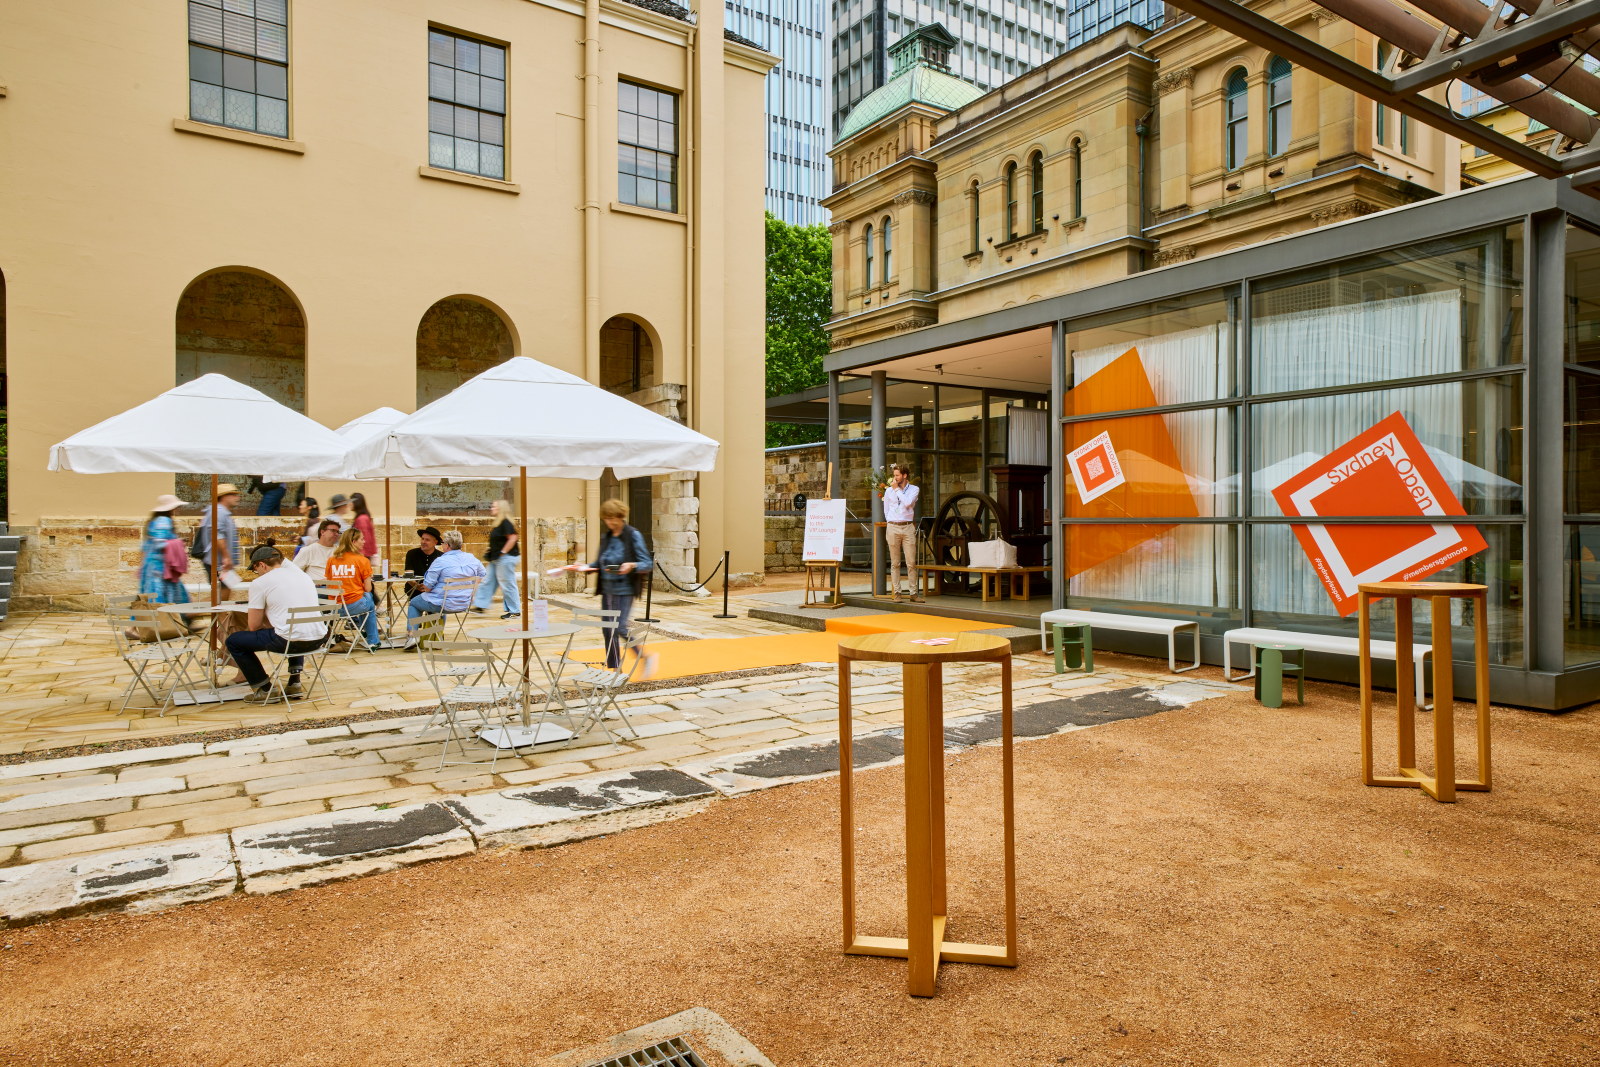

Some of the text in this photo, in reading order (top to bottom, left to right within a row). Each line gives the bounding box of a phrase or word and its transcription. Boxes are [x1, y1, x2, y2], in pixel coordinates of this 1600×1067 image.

[1073, 433, 1108, 458] SYDNEY OPEN
[1108, 451, 1121, 476] LOUNGE
[1326, 437, 1396, 486] Sydney
[1395, 458, 1433, 512] Open
[331, 564, 356, 576] MH
[1314, 557, 1343, 603] #sydneyisopen
[1402, 545, 1468, 582] #membersgetmore
